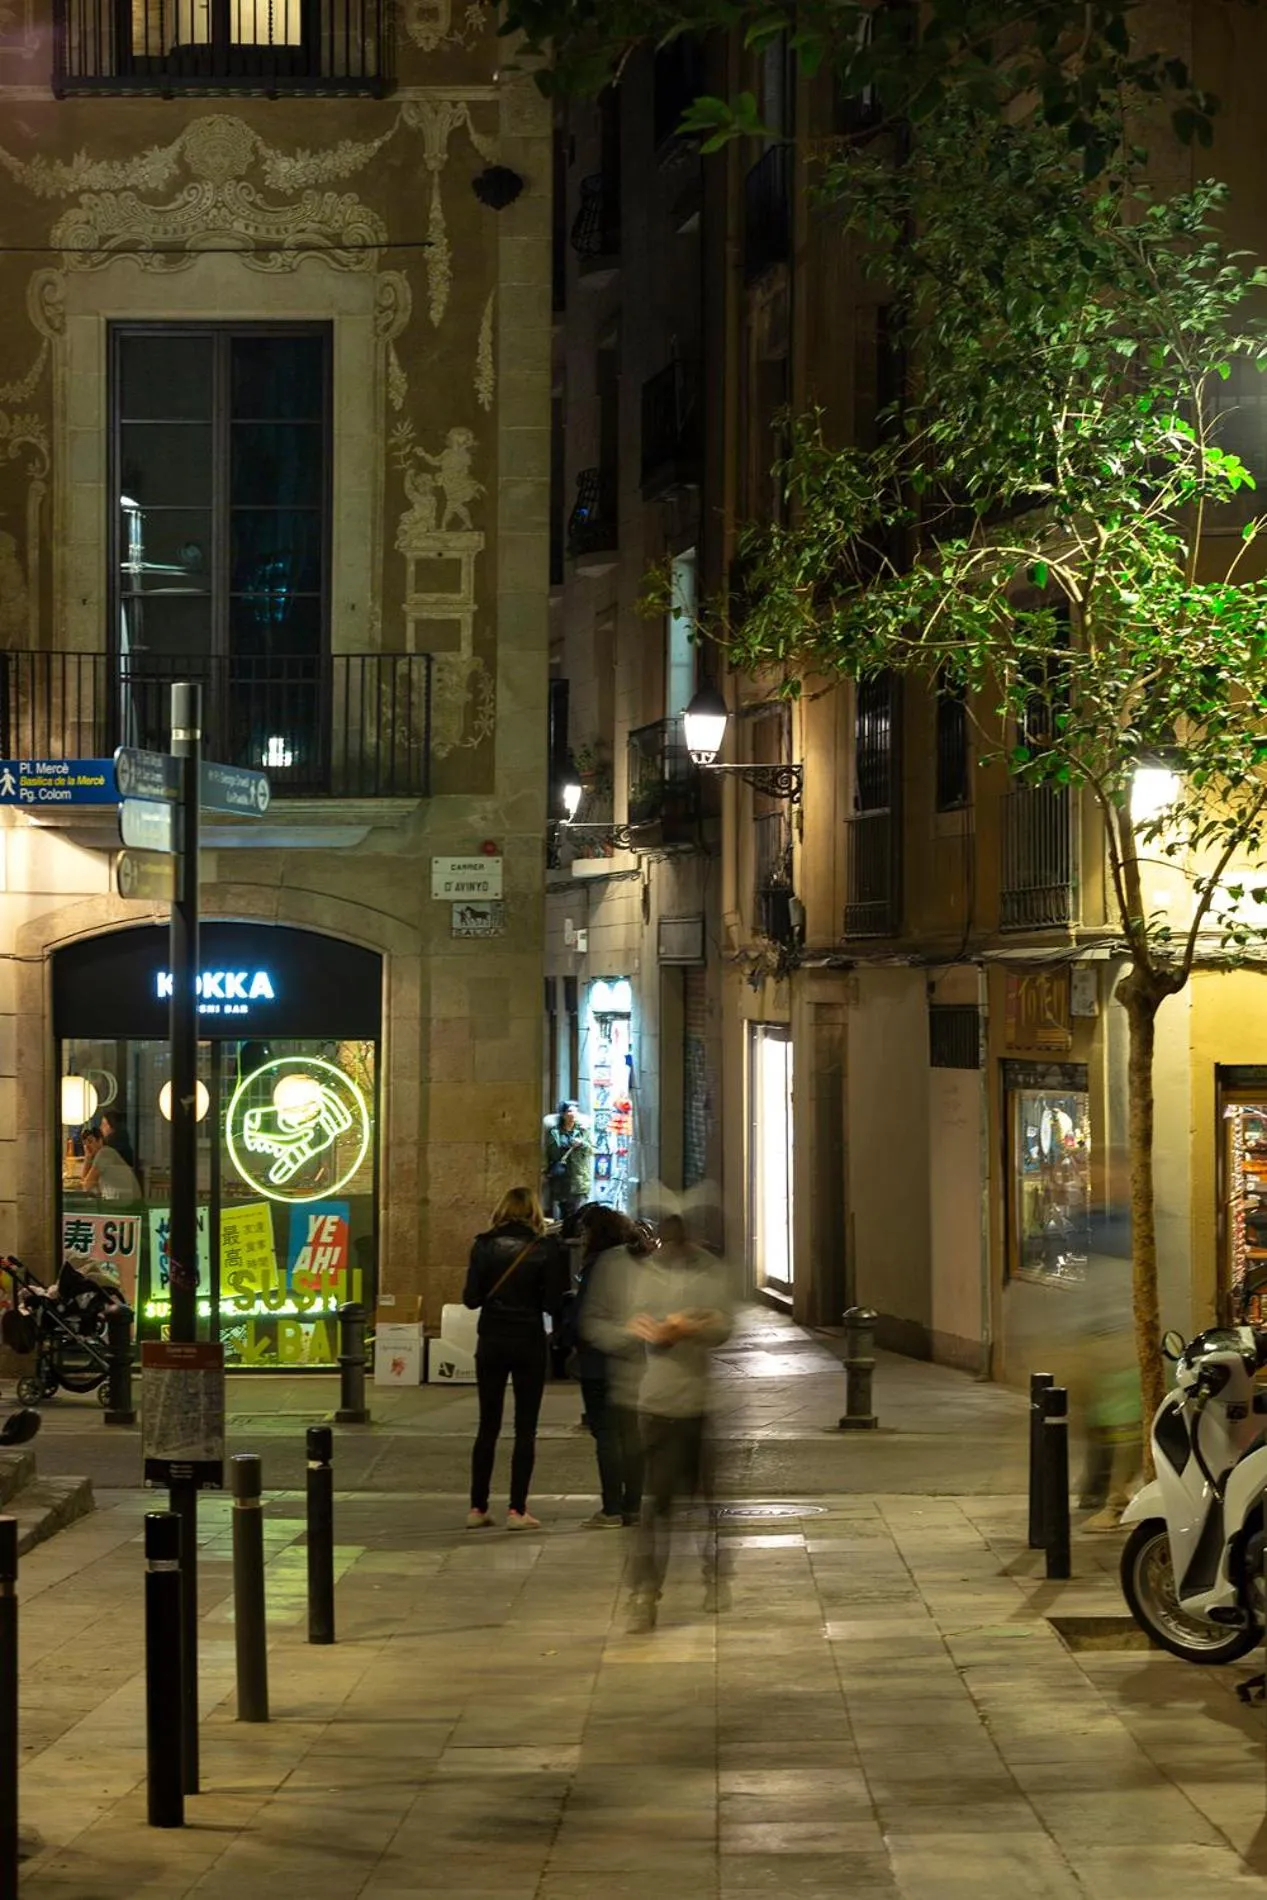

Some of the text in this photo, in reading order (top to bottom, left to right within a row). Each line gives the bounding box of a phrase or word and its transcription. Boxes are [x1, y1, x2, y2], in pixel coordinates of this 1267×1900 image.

[20, 762, 69, 774] Pl. Mercè
[54, 776, 65, 785] de
[67, 776, 75, 785] la
[20, 788, 72, 802] Pg. Colom
[450, 863, 485, 871] CARRER
[157, 972, 275, 999] KKKA
[64, 1219, 95, 1254] 寿
[103, 1220, 135, 1256] SU
[307, 1215, 340, 1243] YE
[291, 1246, 341, 1275] AH!
[231, 1268, 362, 1312] SUSHI
[278, 1319, 342, 1363] BA
